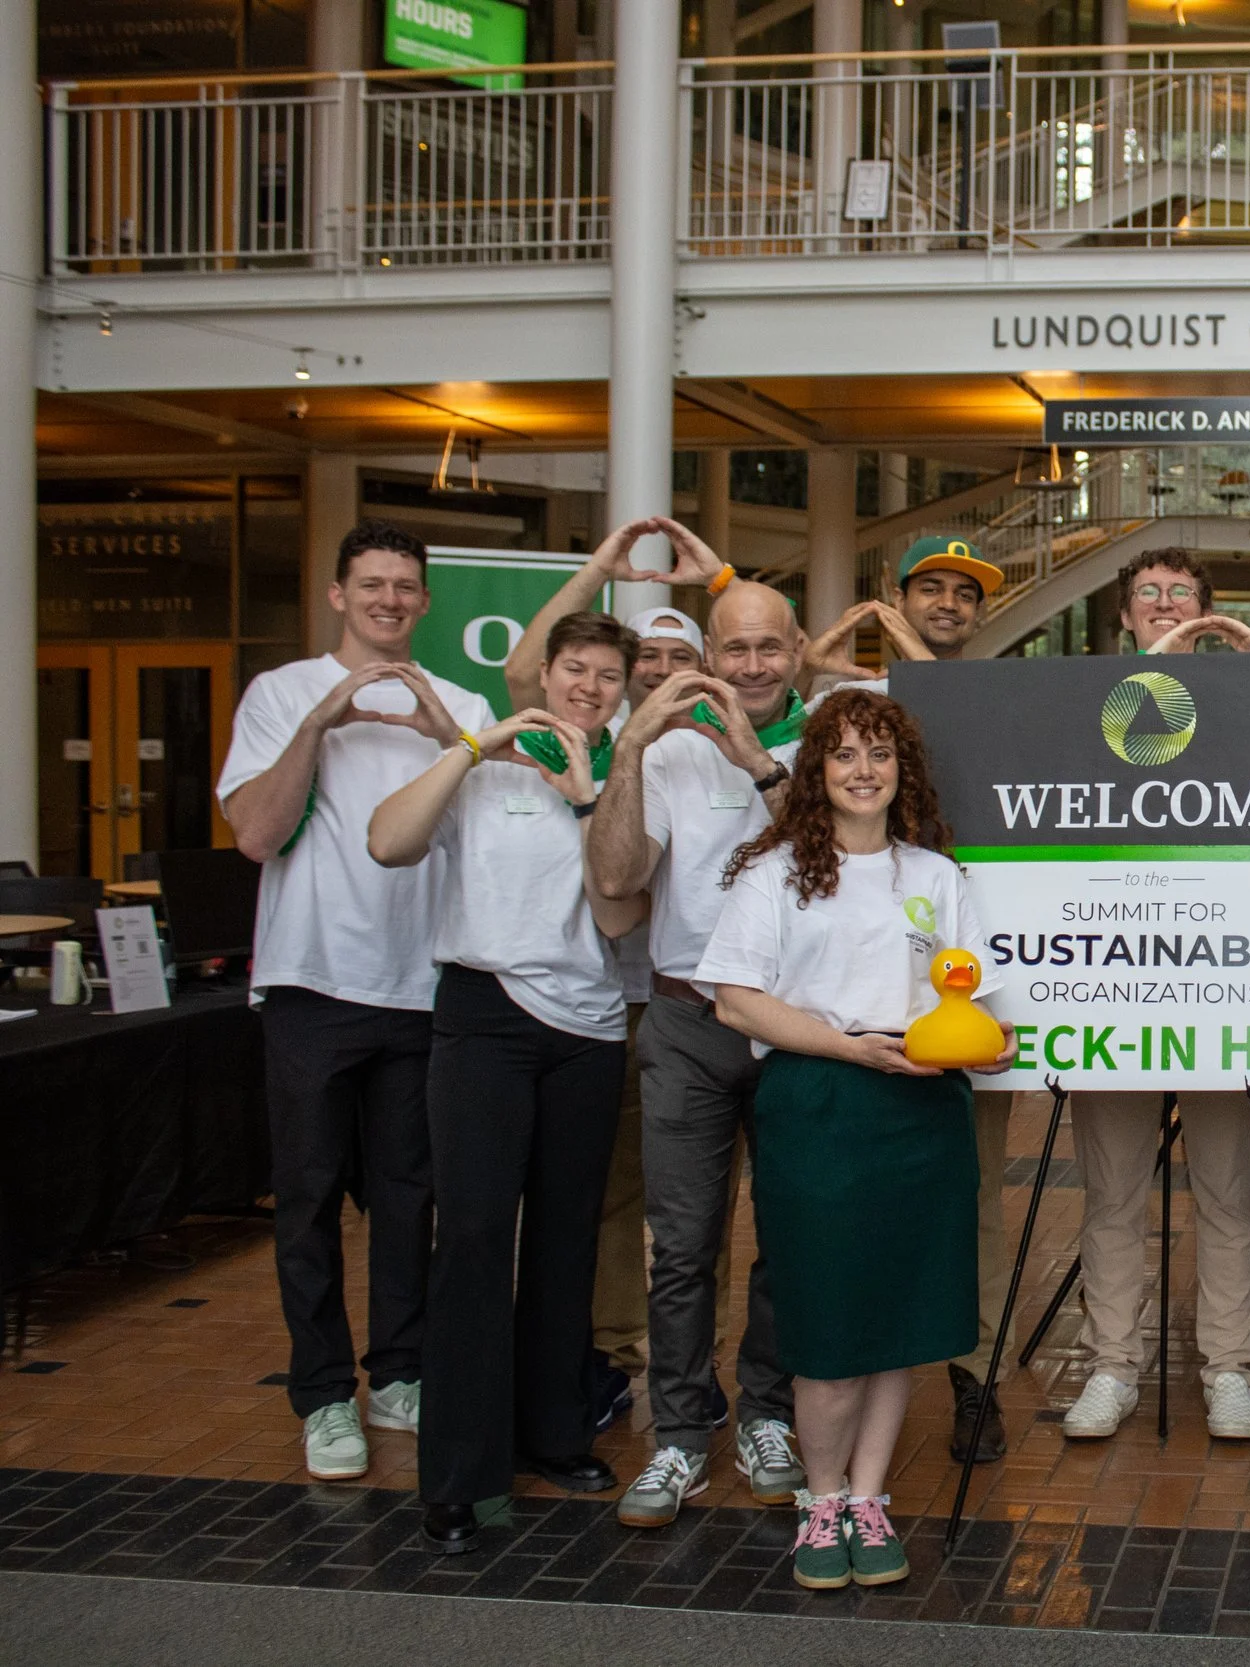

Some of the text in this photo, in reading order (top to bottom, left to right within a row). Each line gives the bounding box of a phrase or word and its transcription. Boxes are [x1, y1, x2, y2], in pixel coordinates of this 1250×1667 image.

[396, 0, 473, 40] HOURS
[992, 313, 1226, 349] LUNDQUIST
[1063, 411, 1185, 431] FREDERICK
[1192, 411, 1212, 431] D.
[51, 534, 182, 556] SERVICES
[463, 615, 525, 667] O
[1125, 871, 1170, 887] to the
[1062, 902, 1227, 922] SUMMIT FOR
[1011, 1024, 1197, 1071] ECK-IN
